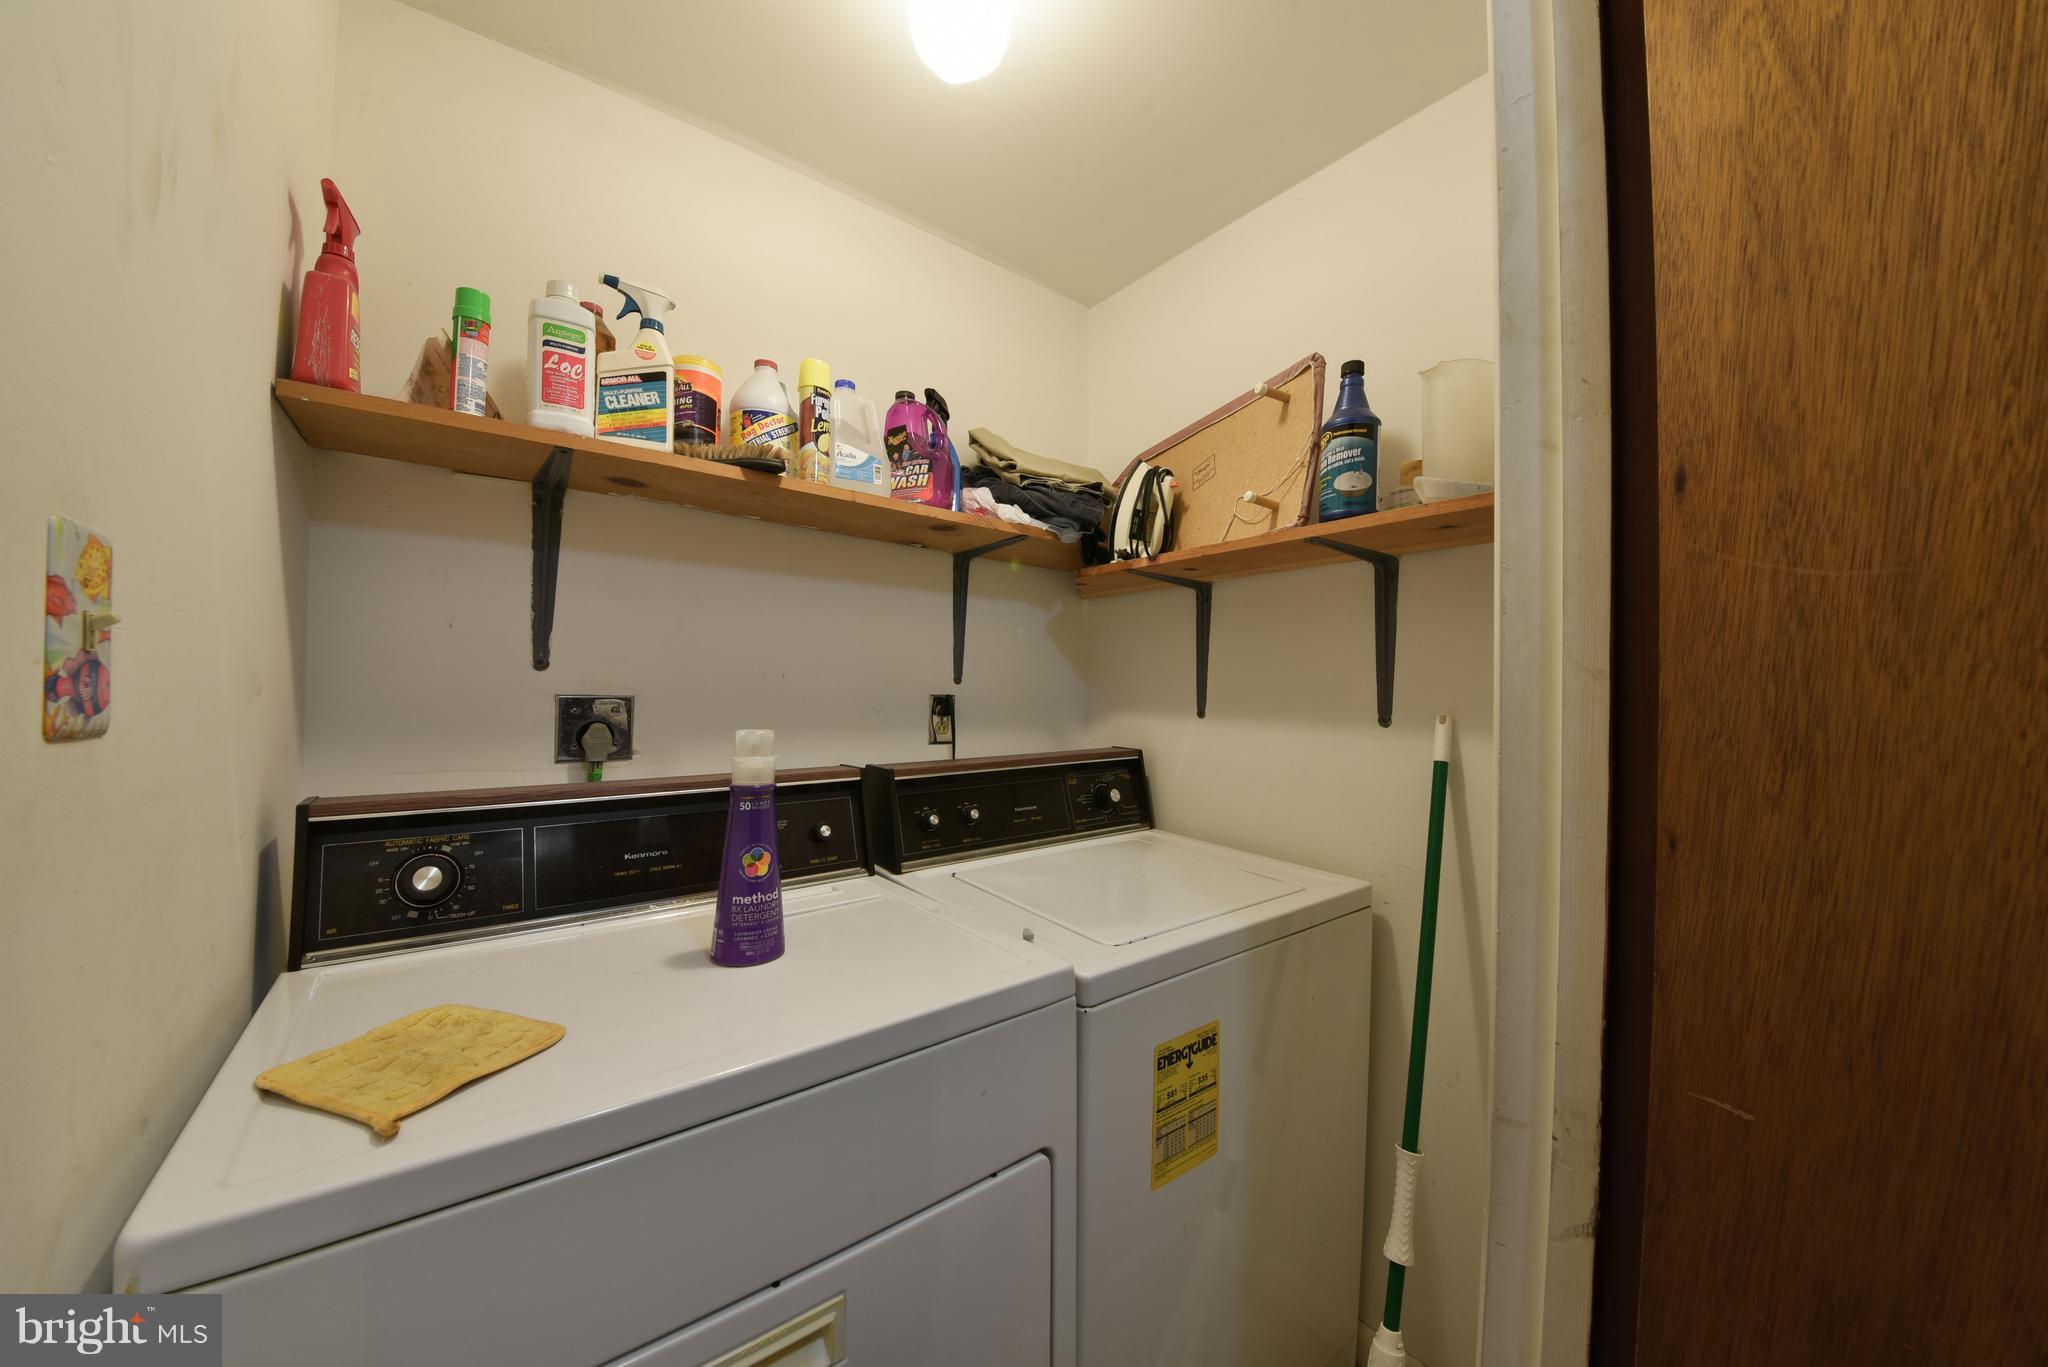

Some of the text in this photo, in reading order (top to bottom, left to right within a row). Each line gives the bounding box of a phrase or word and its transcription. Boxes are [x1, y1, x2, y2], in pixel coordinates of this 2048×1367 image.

[604, 391, 661, 409] CLEANER
[759, 415, 785, 430] Doctor
[1327, 447, 1362, 464] Remover
[905, 464, 929, 475] CAR
[739, 801, 751, 811] 50
[384, 839, 423, 847] AUTOMATIC
[452, 833, 471, 841] CARE
[624, 850, 669, 860] Kenmore
[732, 887, 779, 905] method
[743, 900, 779, 913] LAUNDRY
[731, 908, 779, 922] DETERGENT
